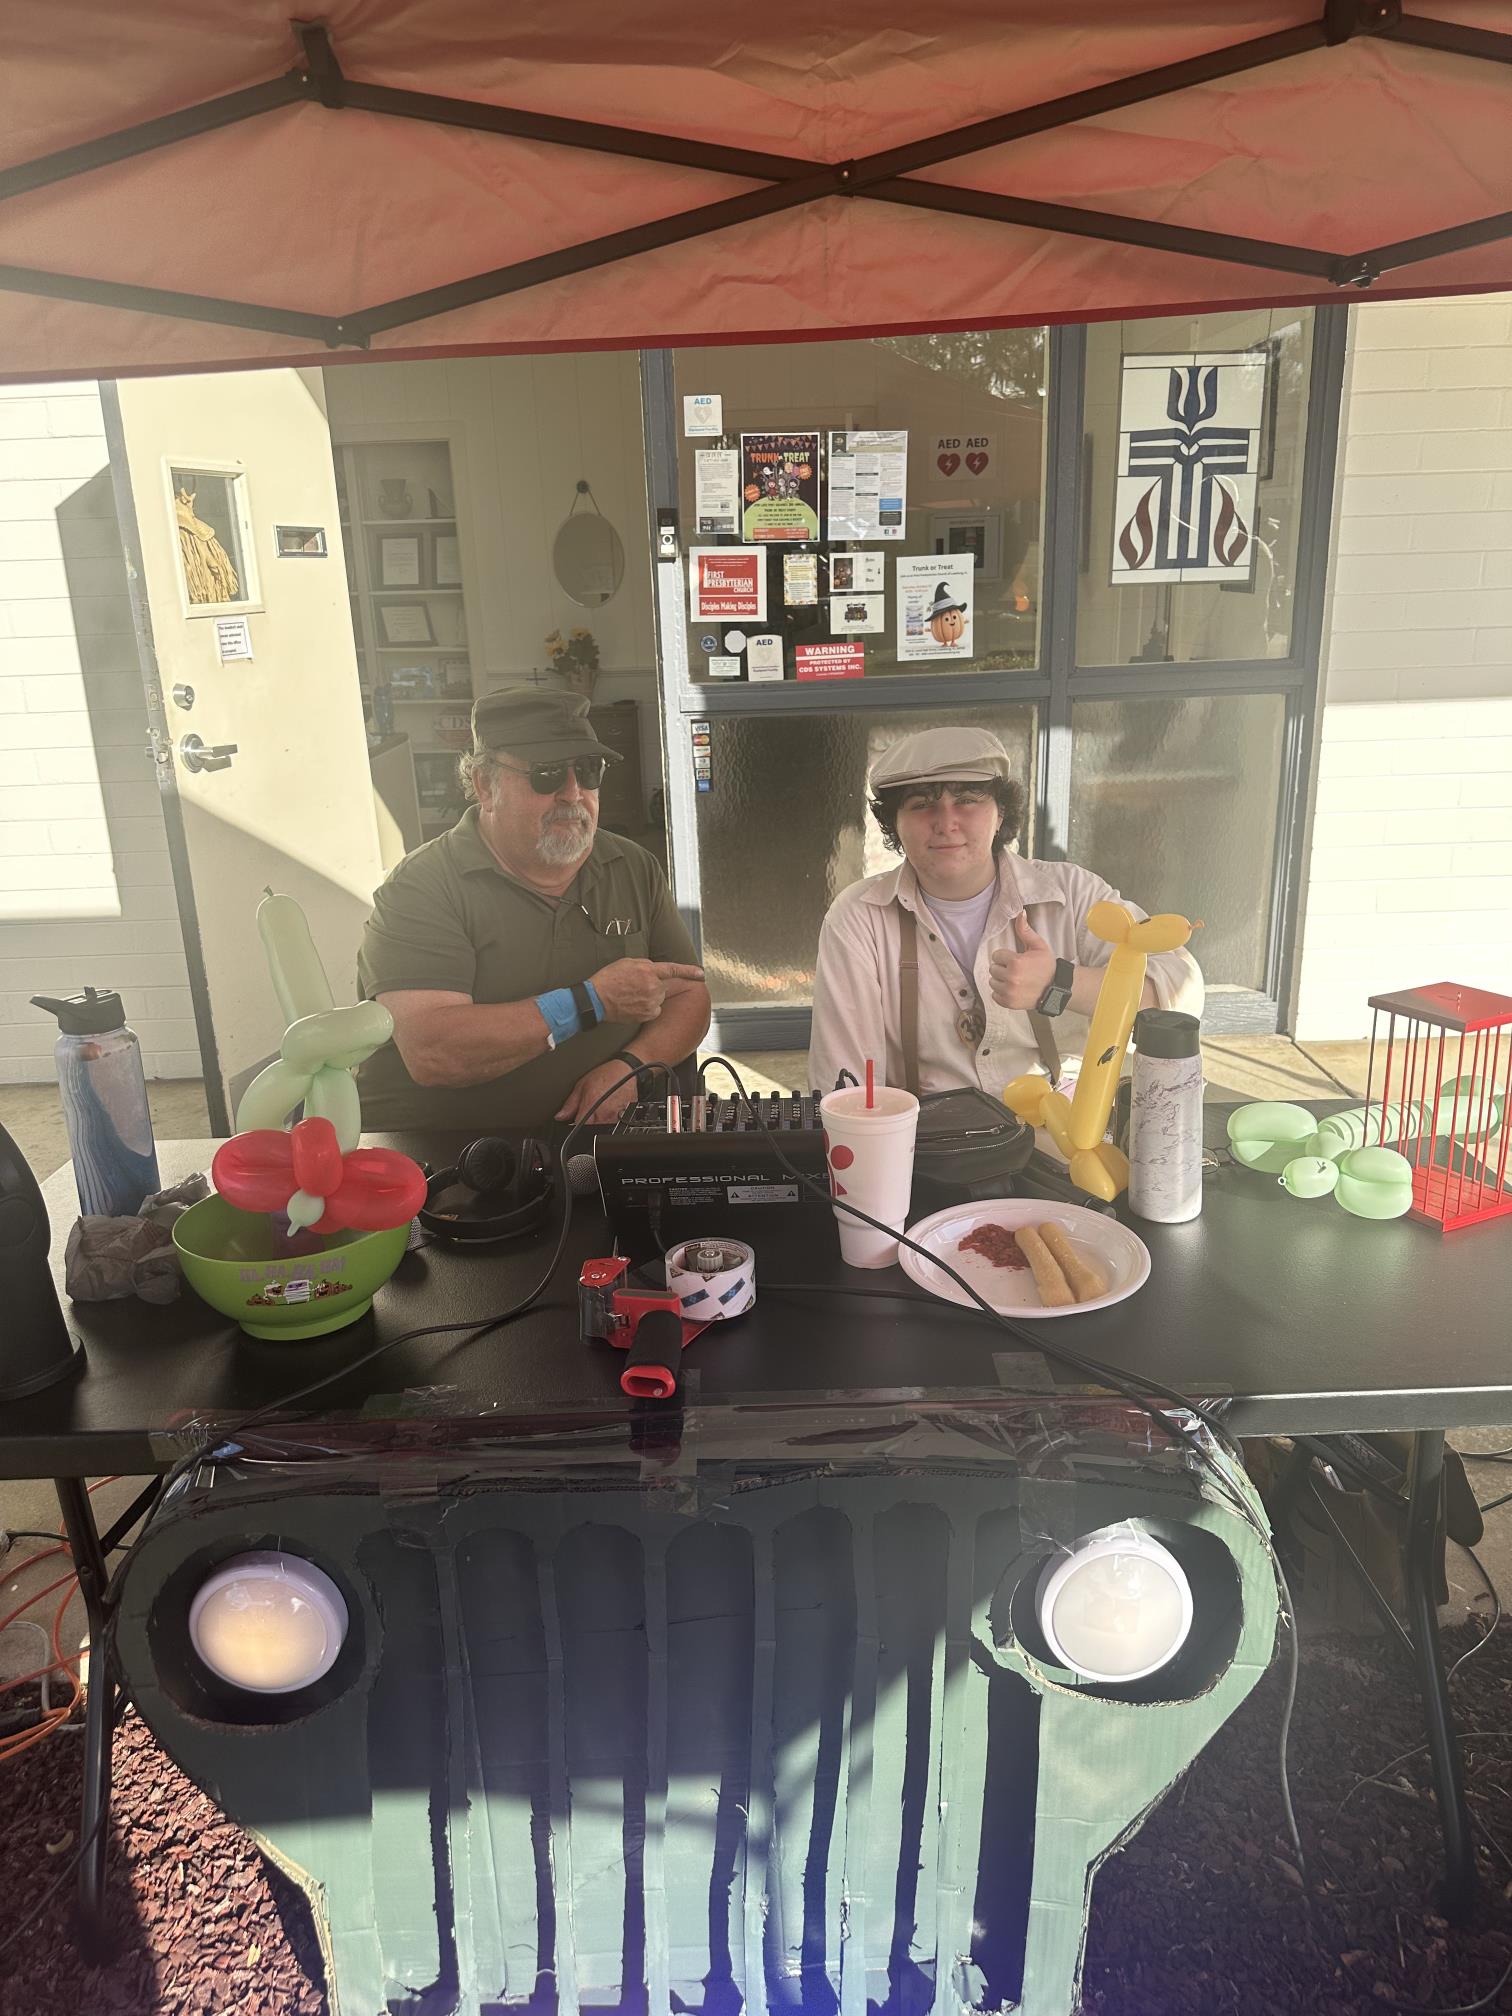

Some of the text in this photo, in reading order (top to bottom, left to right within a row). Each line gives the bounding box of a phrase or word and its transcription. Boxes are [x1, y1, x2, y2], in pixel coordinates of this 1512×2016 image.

[694, 397, 712, 405] AED
[938, 438, 989, 449] AED AED
[751, 452, 778, 463] TRUNK
[783, 452, 810, 463] TREAT
[912, 565, 929, 573] Trunk
[707, 571, 724, 579] FIRST
[707, 578, 753, 588] PRESBYTERIAN
[701, 601, 757, 612] Disciples Making Disciples
[804, 645, 855, 656] WARNING
[621, 1175, 771, 1185] PROFESSIONAL
